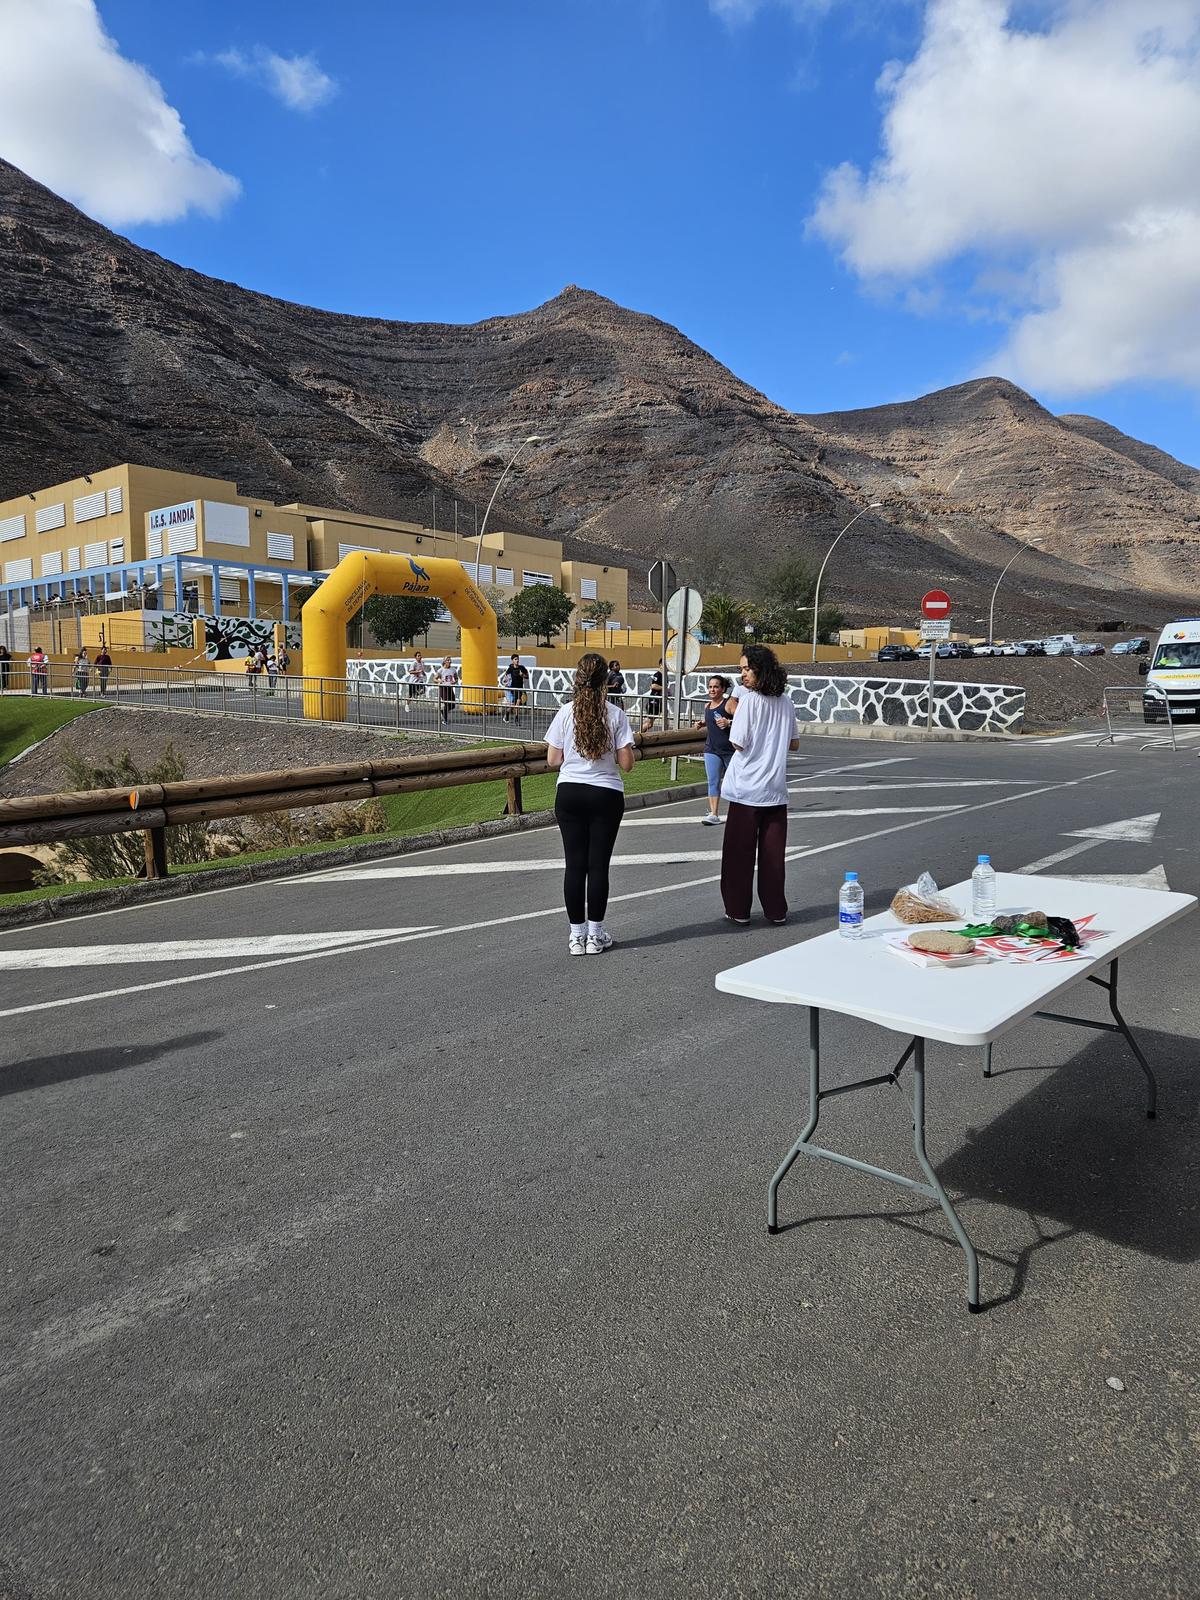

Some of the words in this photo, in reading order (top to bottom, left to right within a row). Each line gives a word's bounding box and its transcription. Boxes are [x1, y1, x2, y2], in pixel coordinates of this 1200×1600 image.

[150, 514, 167, 529] I.E.S.
[169, 507, 195, 525] JANDIA
[402, 581, 430, 593] Pájara
